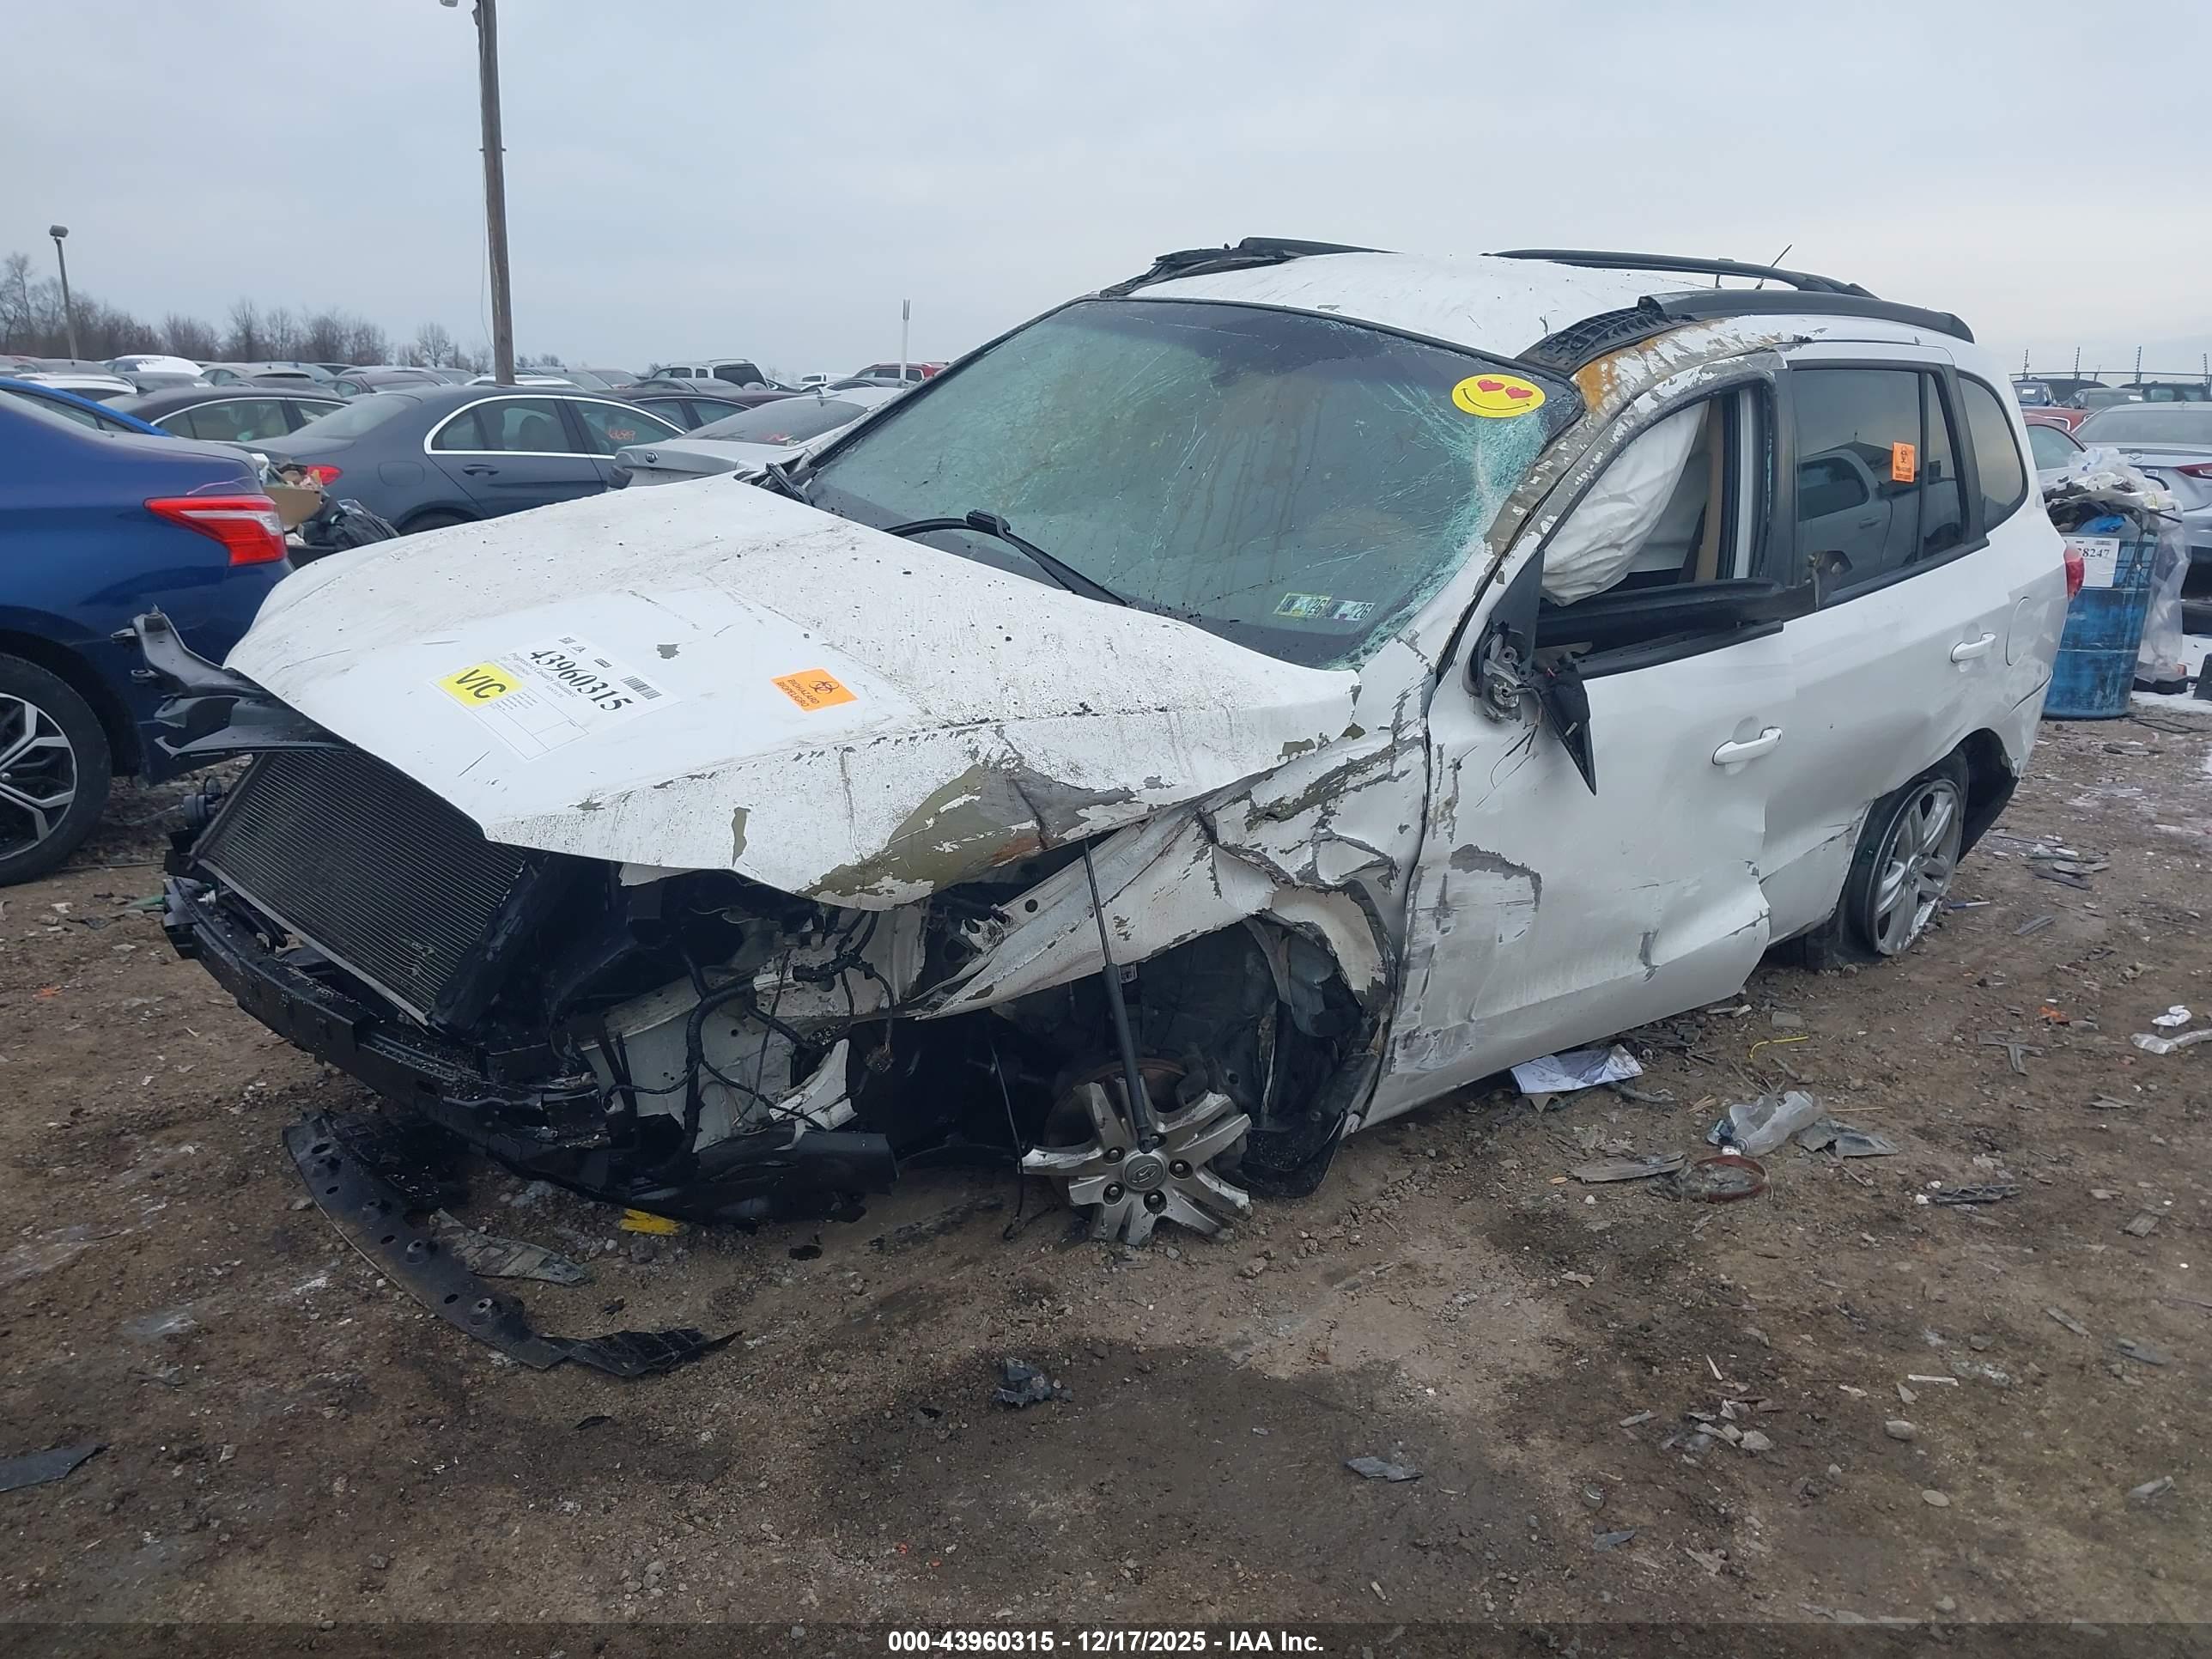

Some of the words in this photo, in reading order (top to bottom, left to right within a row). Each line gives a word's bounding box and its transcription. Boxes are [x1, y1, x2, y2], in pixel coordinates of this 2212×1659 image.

[2077, 547, 2110, 557] 8247
[455, 668, 507, 699] VIC
[530, 650, 634, 711] 43960315
[787, 678, 820, 704] BIOHAZARD
[777, 681, 810, 708] BIOPELIGRO
